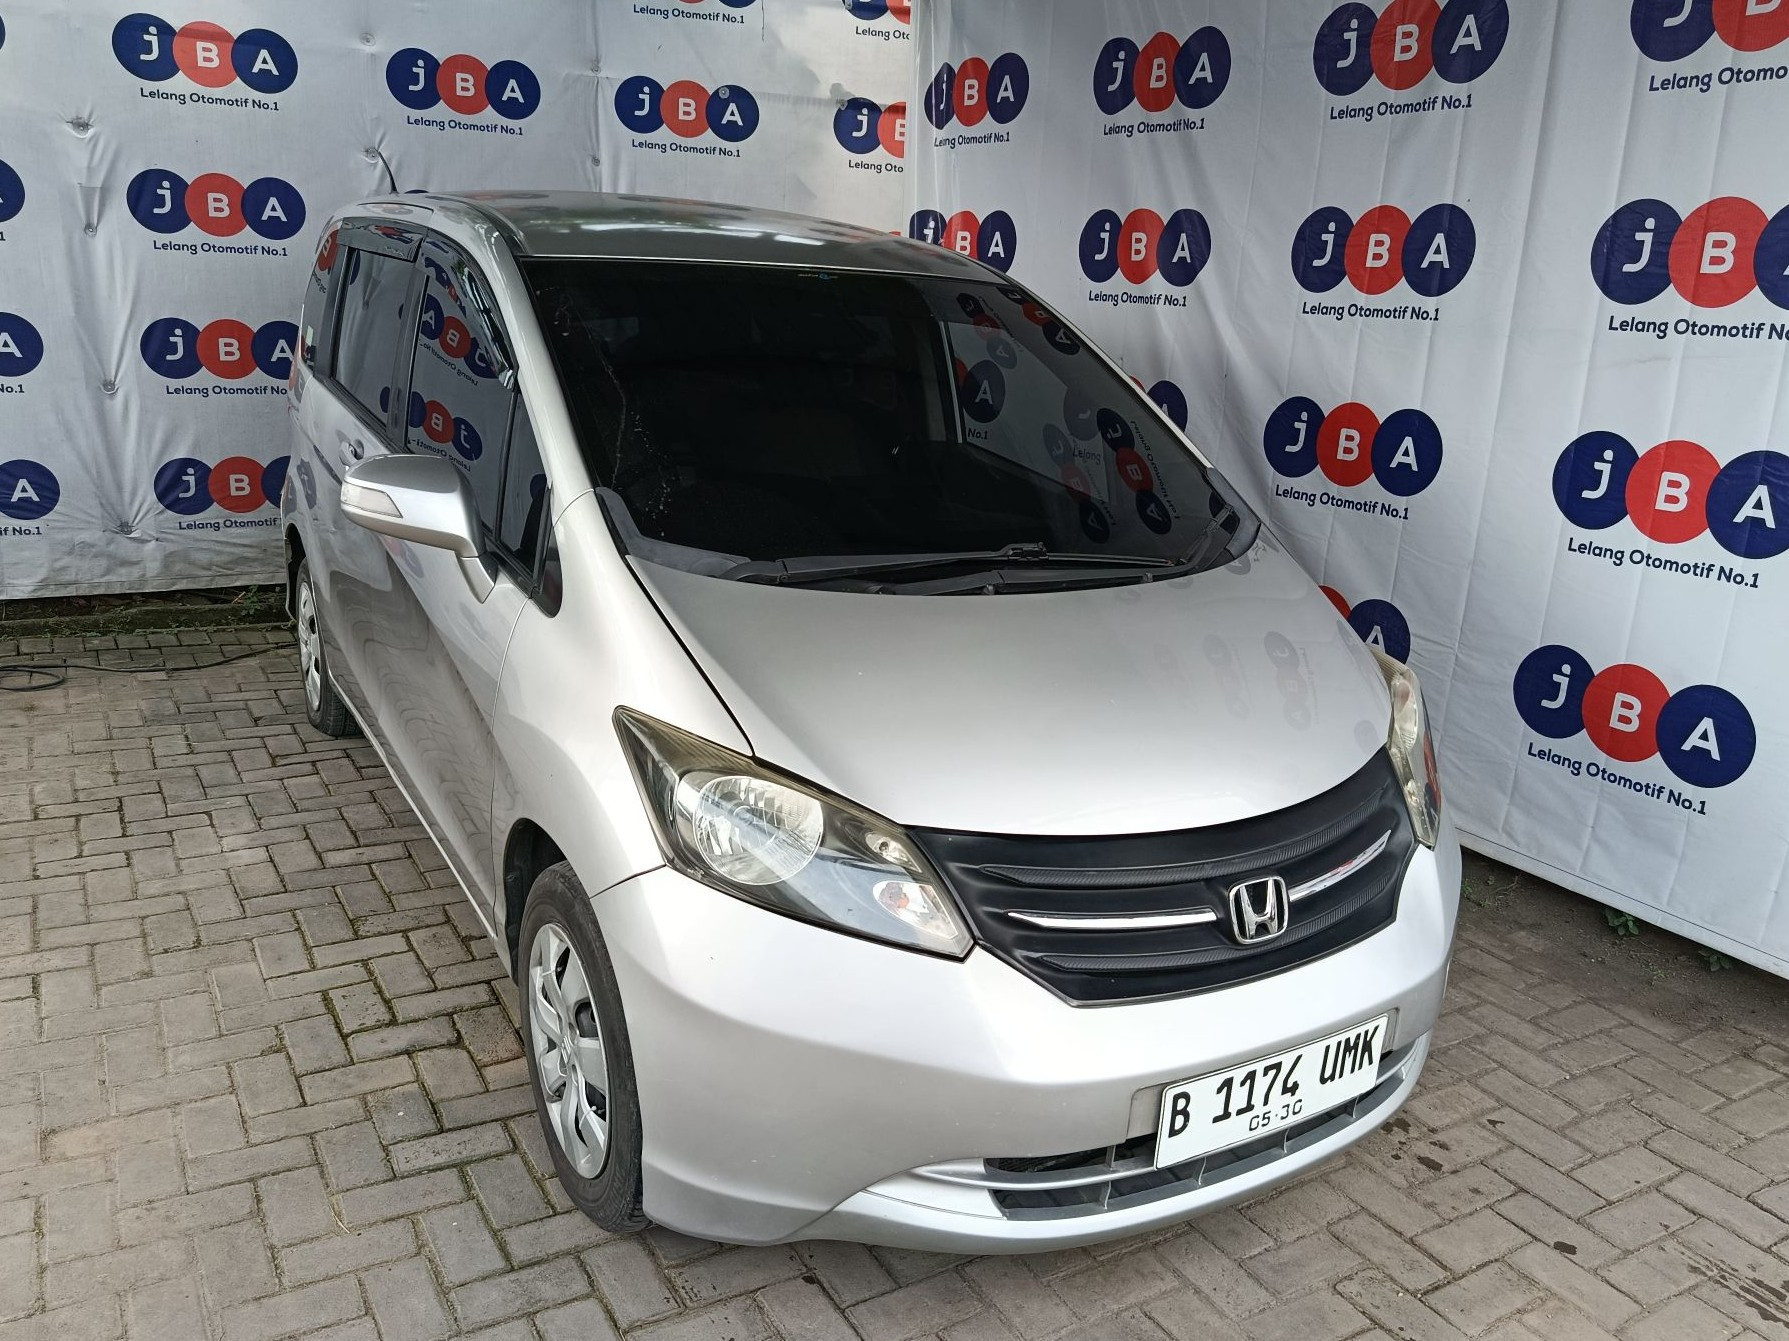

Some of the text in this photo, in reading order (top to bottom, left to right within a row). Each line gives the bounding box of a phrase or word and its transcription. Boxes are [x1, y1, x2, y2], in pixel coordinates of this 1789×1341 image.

[633, 3, 745, 24] Lelang Otomotif No.1
[855, 25, 890, 41] Lelang
[1649, 65, 1788, 93] Lelang Otomo
[140, 87, 279, 111] Lelang Otomotif No.1
[1330, 93, 1472, 122] Lelang Otomotif No.1
[407, 115, 523, 135] Lelang Otomotif No.1
[1103, 118, 1205, 138] Lelang Otomotif No.1
[957, 132, 992, 145] Otomotif
[994, 131, 1010, 143] No.1
[632, 139, 741, 158] Lelang Otomotif No.1
[849, 160, 904, 174] Lelang Oto
[153, 240, 288, 257] Lelang Otomotif No.1
[1088, 290, 1187, 307] Lelang Otomotif No.1
[1302, 301, 1440, 321] Lelang Otomotif No.1
[1608, 315, 1669, 340] Lelang
[1674, 318, 1765, 339] Otomotif
[166, 385, 209, 398] Lelang
[212, 385, 268, 395] Otomotif
[1275, 484, 1409, 520] Lelang Otomotif No.1
[12, 526, 42, 536] No.1
[178, 517, 278, 531] Lelang Otomotif
[1567, 537, 1760, 589] Lelang Otomotif No.1
[1528, 741, 1707, 815] Lelang Otomotif No.1
[1168, 1024, 1380, 1138] B 1174 UMK
